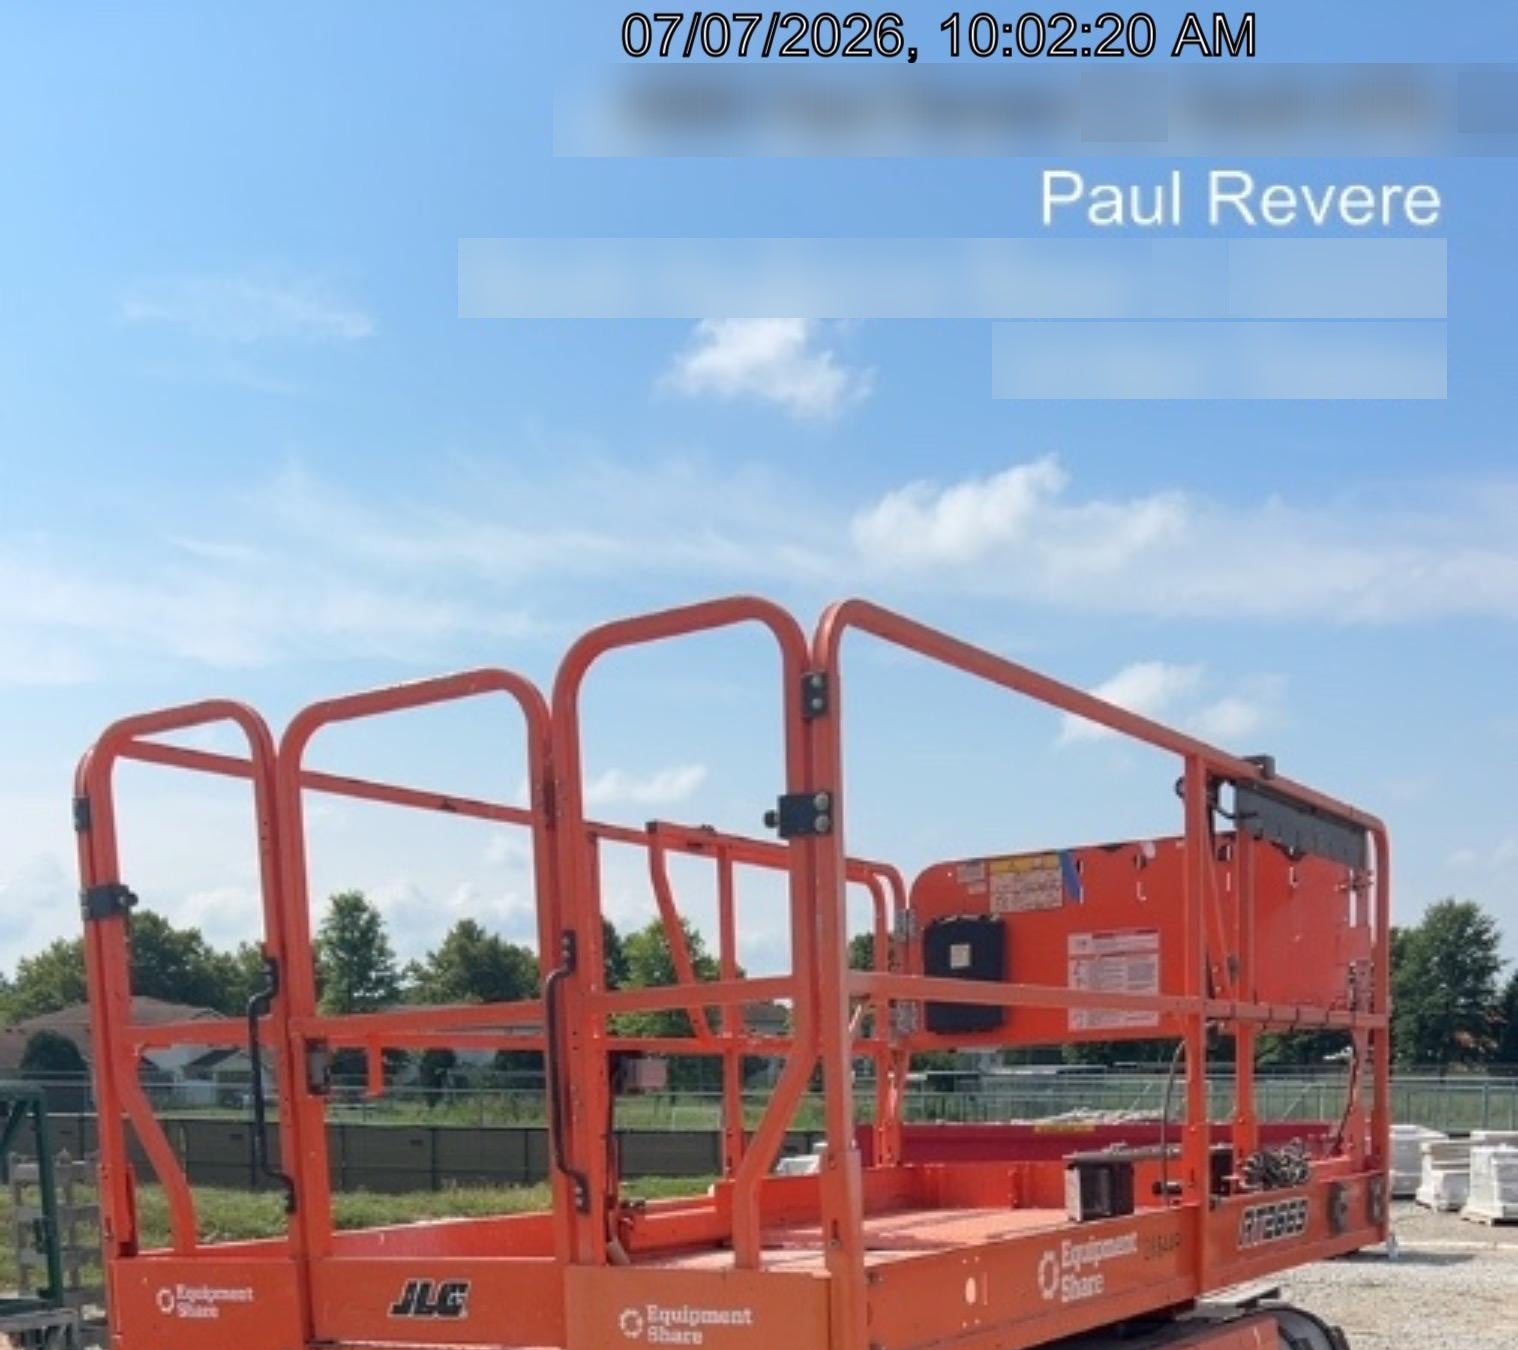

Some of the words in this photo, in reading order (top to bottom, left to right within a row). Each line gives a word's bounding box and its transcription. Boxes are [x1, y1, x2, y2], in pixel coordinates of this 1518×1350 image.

[1061, 1231, 1139, 1272] Equipment
[176, 1283, 254, 1303] Equipment
[387, 1278, 471, 1320] JLG
[1061, 1273, 1105, 1303] Share
[177, 1300, 220, 1318] Share
[645, 1304, 754, 1327] Equipment
[646, 1325, 704, 1345] Share
